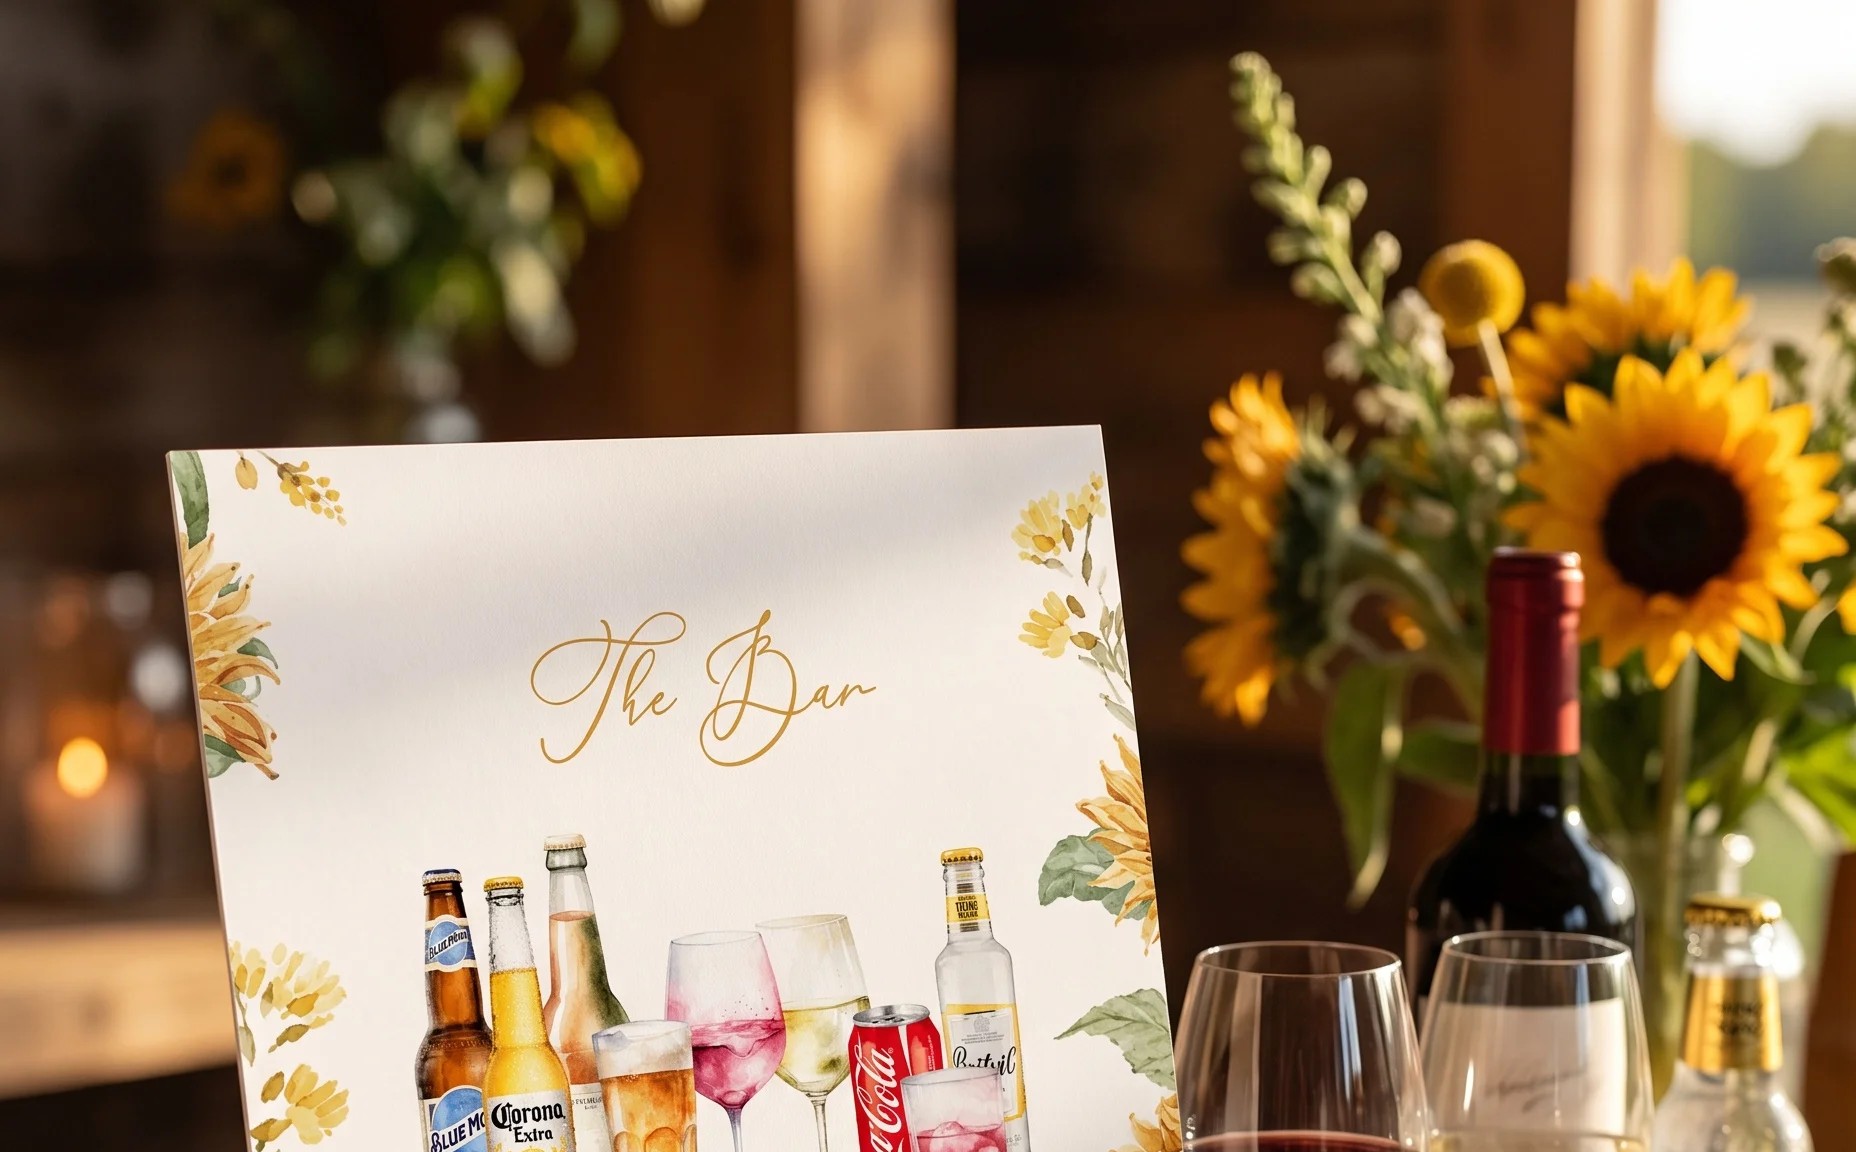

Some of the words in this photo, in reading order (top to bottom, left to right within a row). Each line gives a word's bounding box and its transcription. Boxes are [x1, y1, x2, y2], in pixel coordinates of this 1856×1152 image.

[531, 612, 686, 764] The
[698, 608, 877, 768] Bar
[468, 1112, 485, 1137] MO
[491, 1102, 566, 1131] Corona
[514, 1126, 553, 1143] Extra
